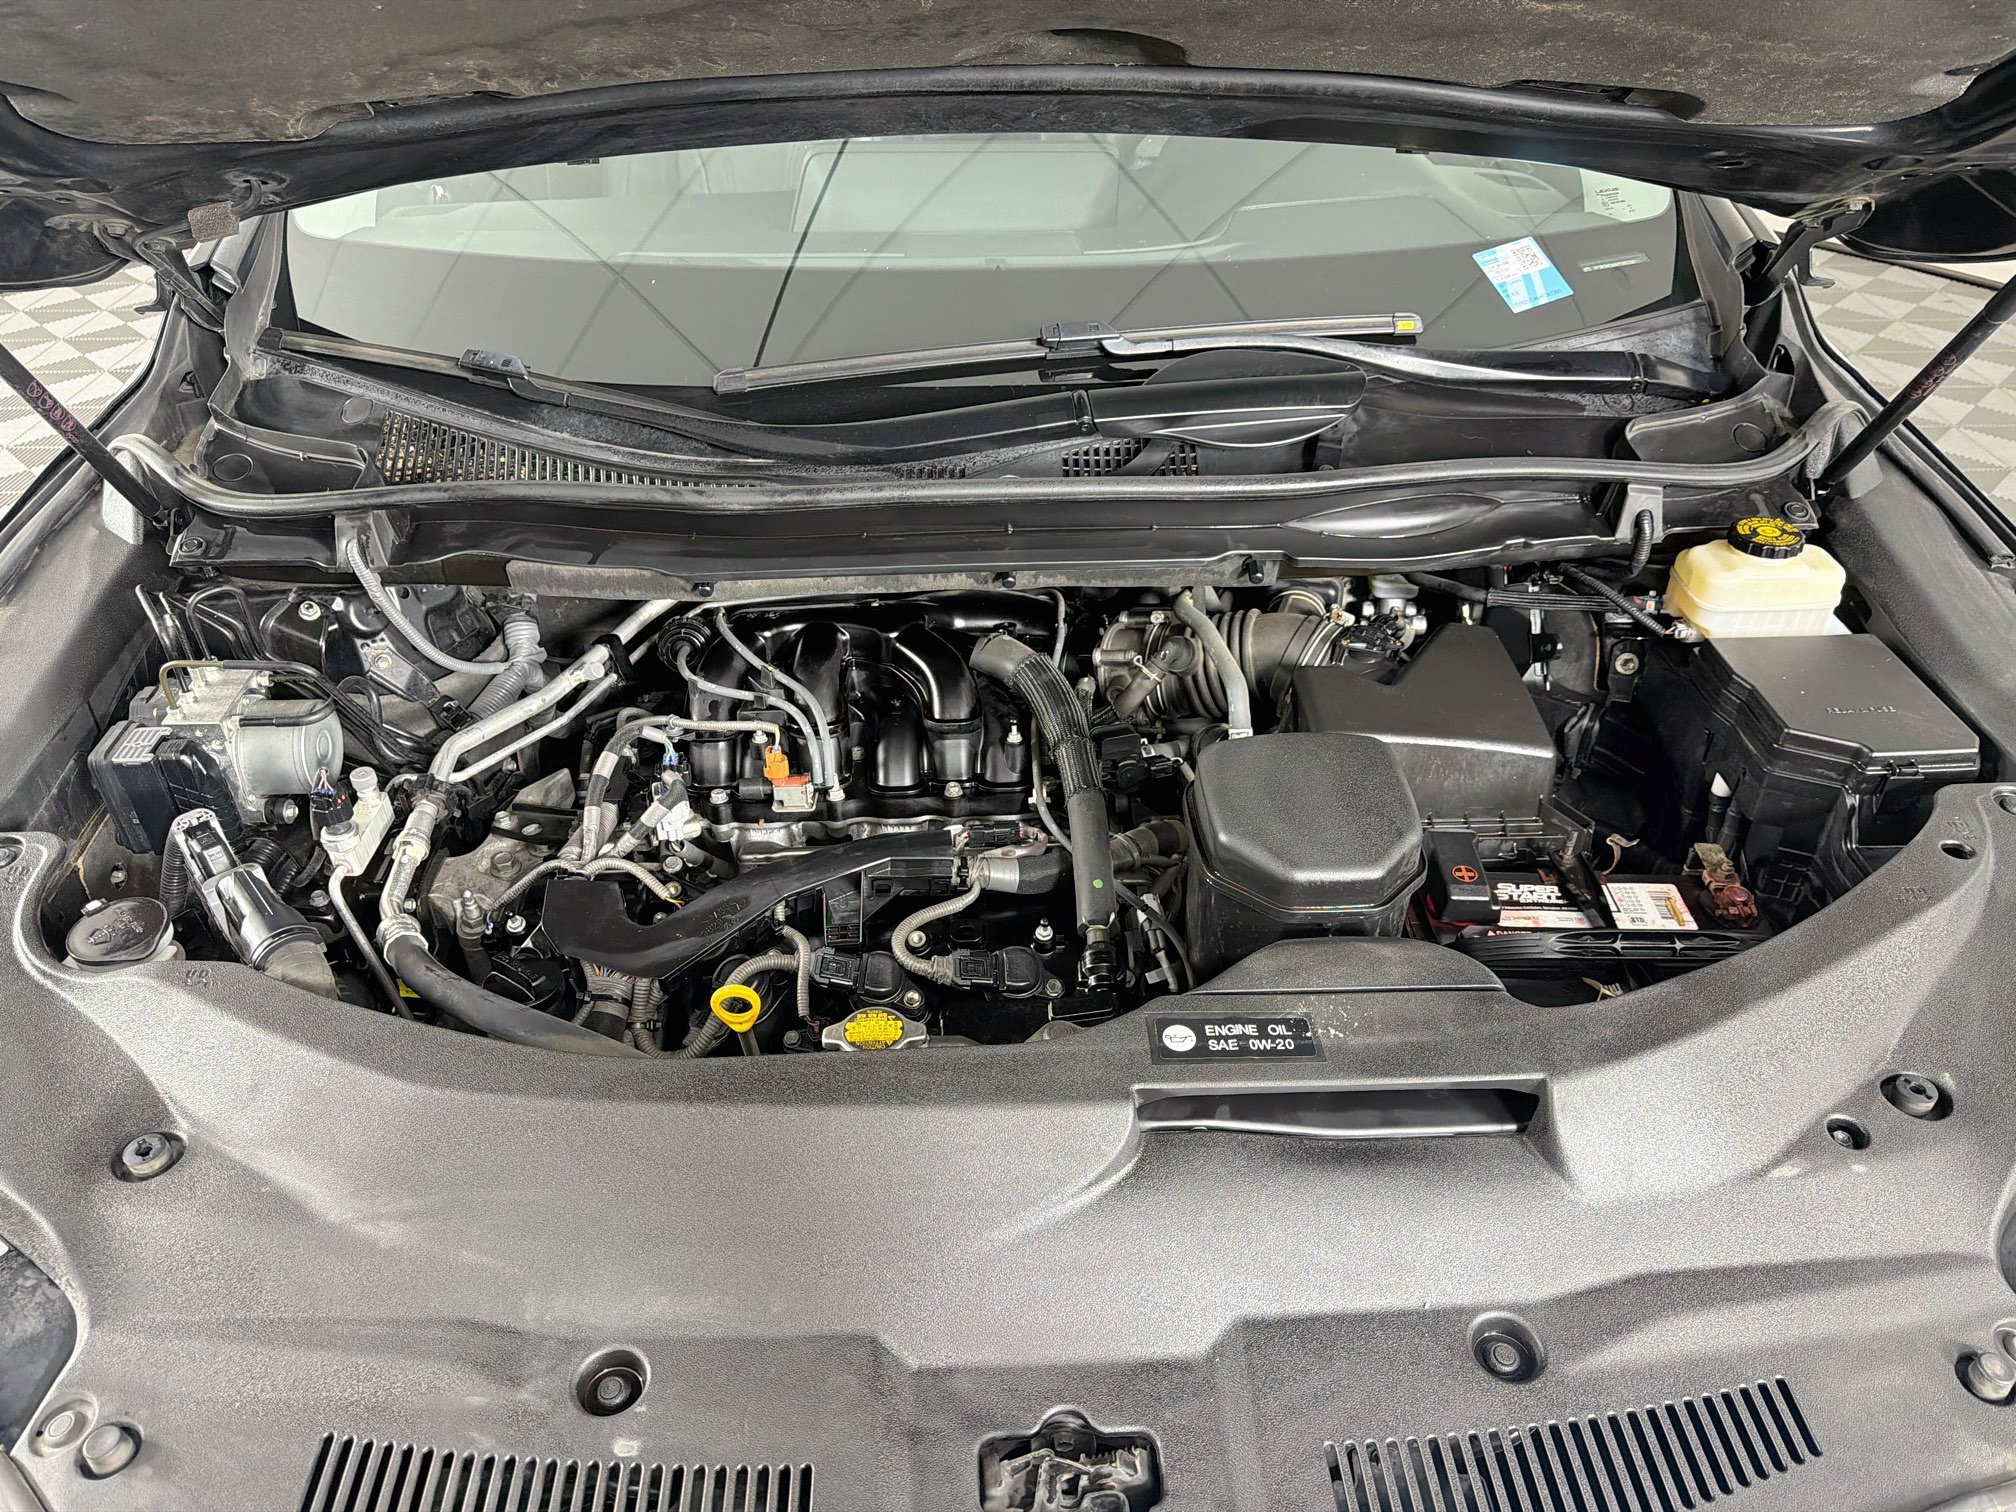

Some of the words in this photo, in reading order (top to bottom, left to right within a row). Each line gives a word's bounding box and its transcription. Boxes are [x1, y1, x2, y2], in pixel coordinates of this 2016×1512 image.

[1497, 882, 1559, 893] SUPER
[1494, 890, 1562, 901] START
[1204, 1024, 1258, 1036] ENGINE
[1267, 1024, 1292, 1036] OIL
[1208, 1039, 1239, 1051] SAE
[1249, 1039, 1295, 1050] 0W-20
